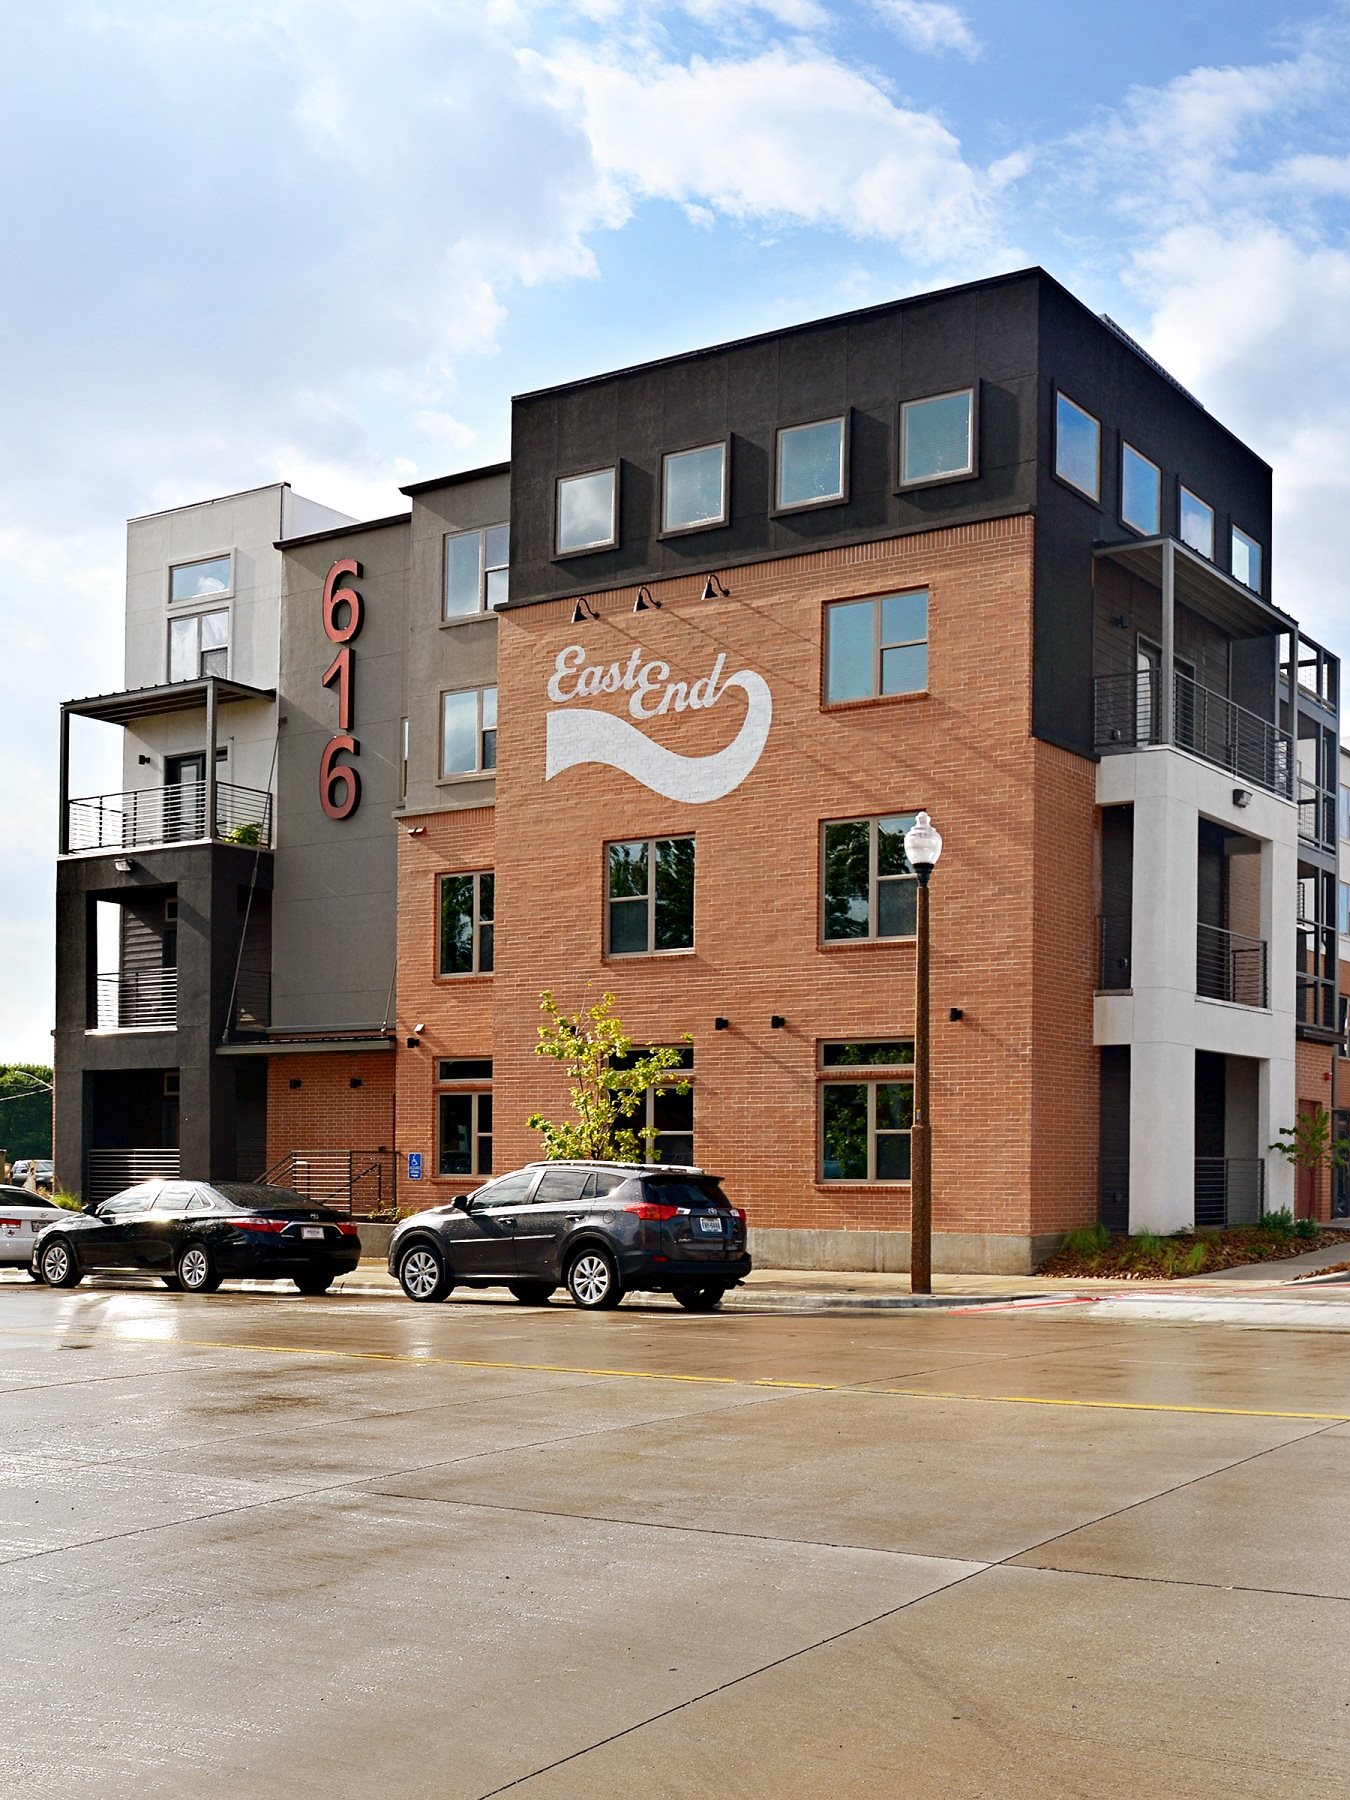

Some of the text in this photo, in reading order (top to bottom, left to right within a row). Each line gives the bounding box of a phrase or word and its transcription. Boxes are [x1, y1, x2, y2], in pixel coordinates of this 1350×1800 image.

[320, 558, 364, 821] 616
[546, 645, 642, 703] East
[629, 652, 726, 720] End
